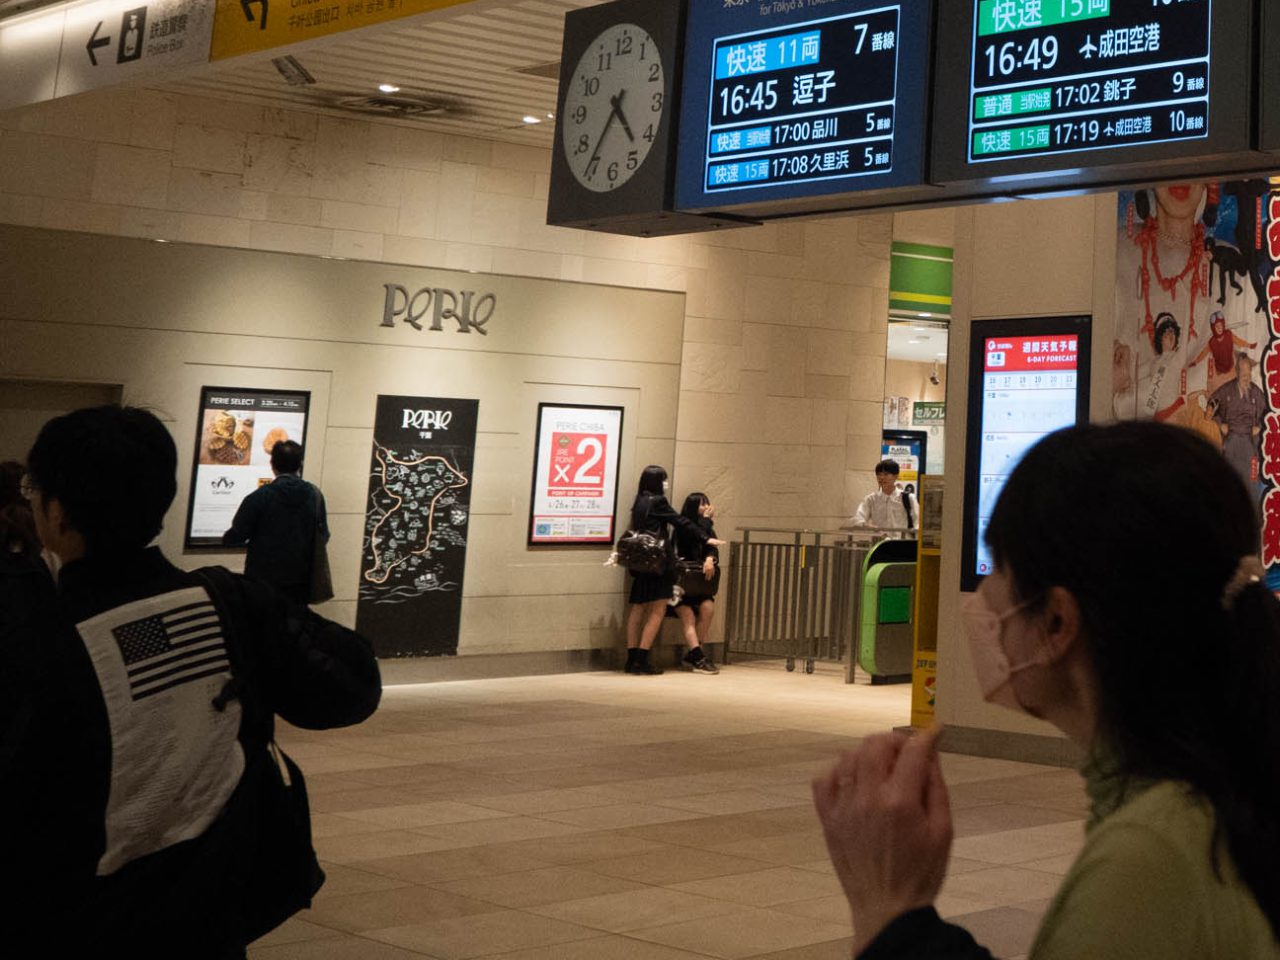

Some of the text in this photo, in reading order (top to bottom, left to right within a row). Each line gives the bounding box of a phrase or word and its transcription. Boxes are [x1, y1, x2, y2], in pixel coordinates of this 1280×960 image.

[760, 5, 771, 16] for
[615, 36, 632, 55] 12
[639, 43, 645, 60] 1
[985, 23, 1160, 77] 16:49 成田空港
[598, 52, 612, 72] 11
[727, 41, 767, 76] 快速
[648, 64, 659, 82] 2
[583, 78, 599, 96] 10
[720, 70, 836, 116] 16:45 逗子
[651, 93, 662, 112] 3
[983, 78, 1136, 116] 普通 17:02 銚子
[576, 106, 586, 124] 9
[643, 124, 655, 142] 4
[717, 118, 838, 152] 快速 17:00 品川
[981, 116, 1151, 152] 快速 17:19 成田空港
[578, 135, 588, 153] 8
[590, 156, 601, 175] 7
[627, 151, 638, 170] 5
[716, 150, 849, 183] 快速 17:08 久里浜
[607, 162, 618, 181] 6
